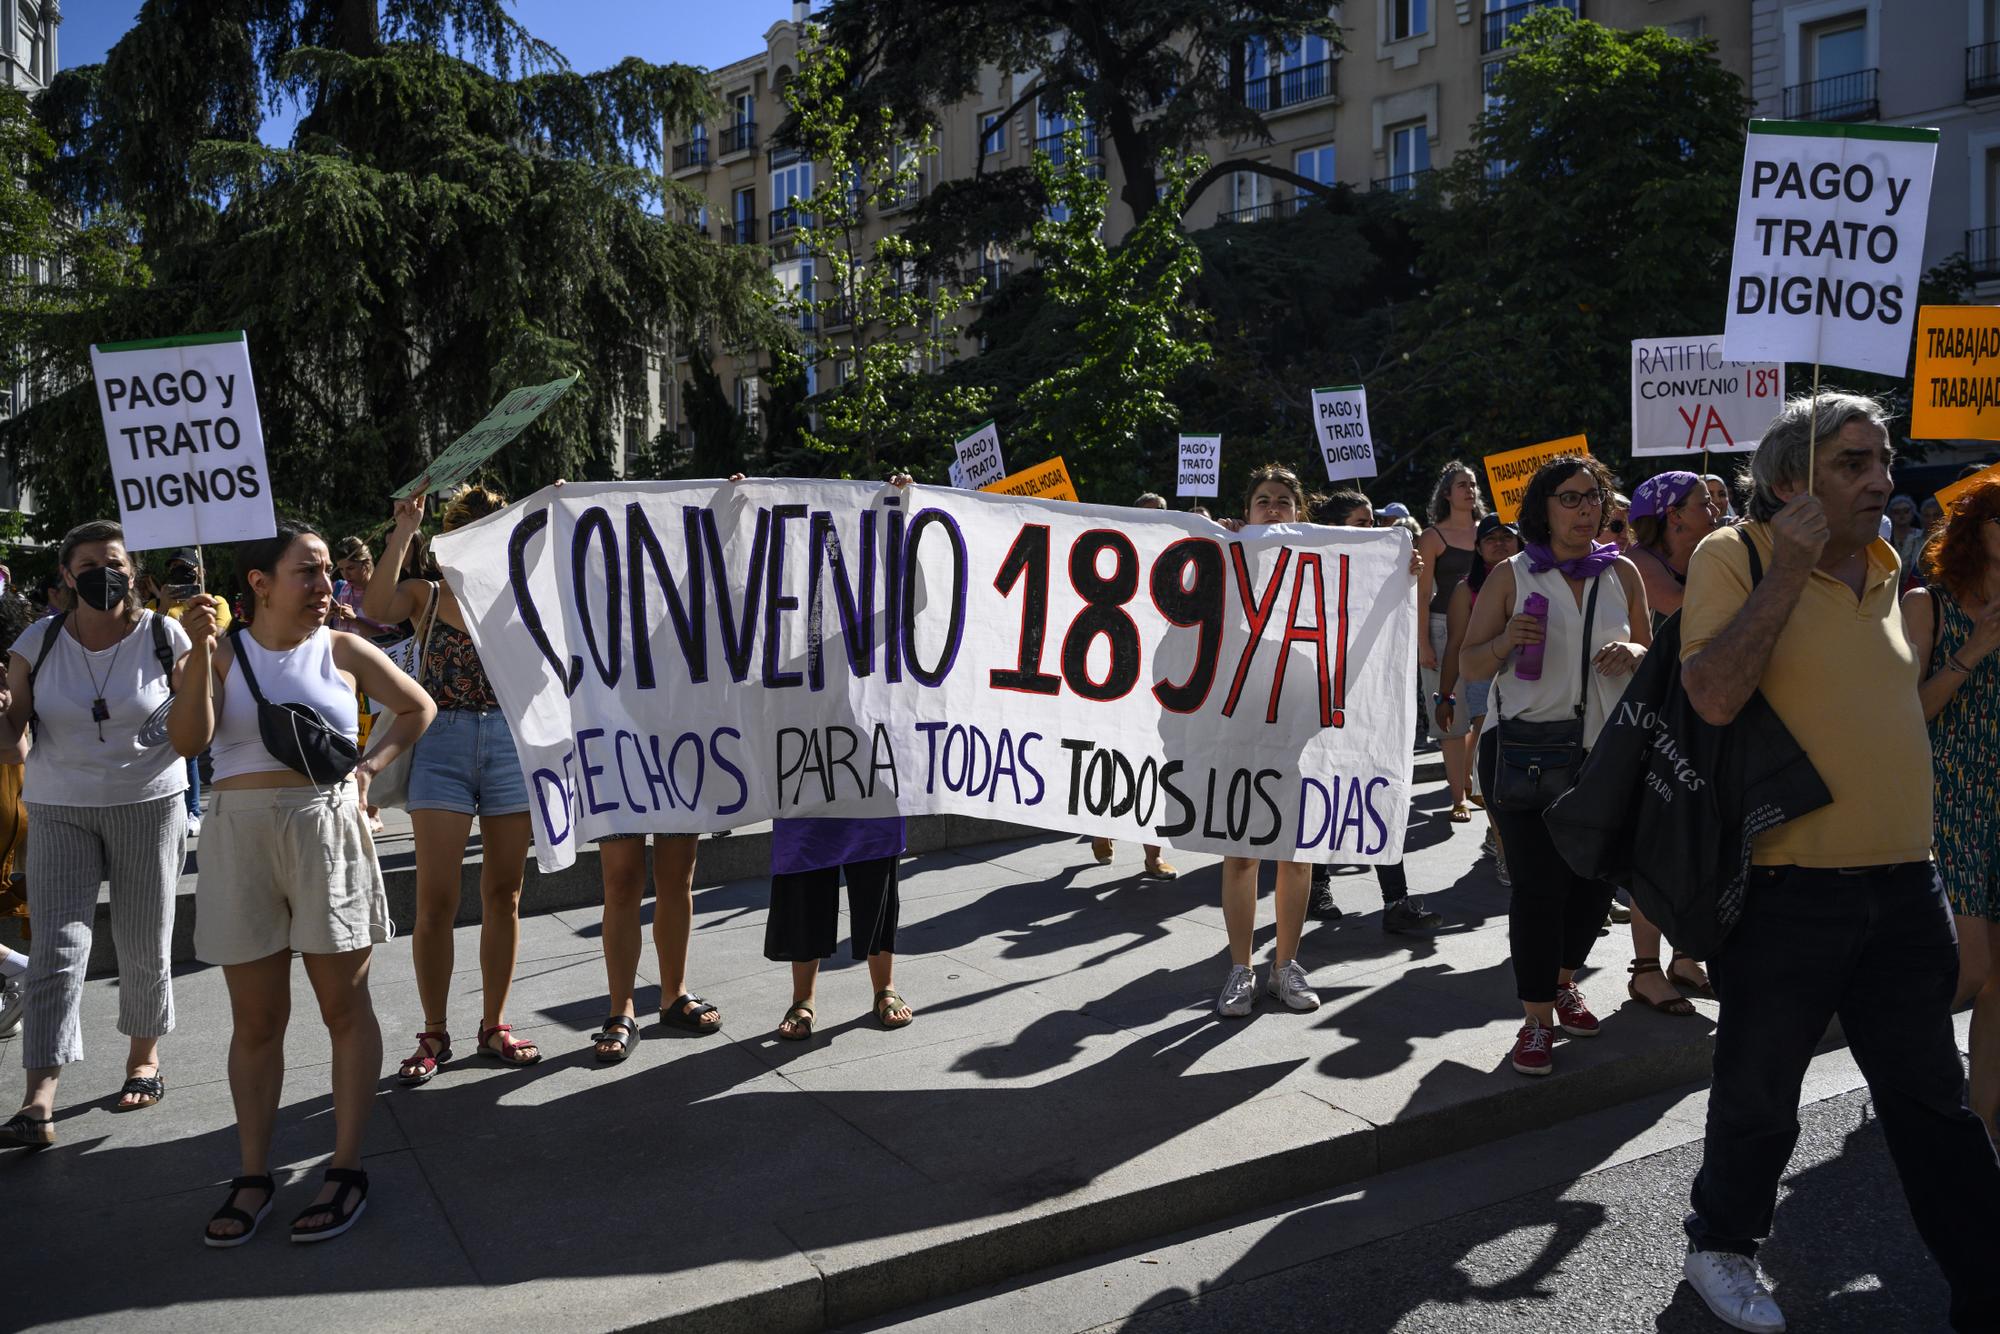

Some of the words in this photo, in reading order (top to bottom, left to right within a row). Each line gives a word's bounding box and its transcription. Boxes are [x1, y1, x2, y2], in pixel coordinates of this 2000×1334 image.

[1751, 161, 1873, 202] PAGO
[1885, 177, 1911, 216] y
[1756, 218, 1898, 264] TRATO
[1736, 276, 1903, 325] DIGNOS
[104, 369, 206, 411] PAGO
[216, 374, 235, 408] y
[1641, 377, 1738, 400] CONVENIO
[1747, 368, 1778, 398] 189
[1320, 401, 1351, 419] PAGO
[1355, 403, 1361, 419] y
[120, 416, 240, 460] TRATO
[1326, 422, 1364, 441] TRATO
[1678, 404, 1734, 449] YA
[960, 438, 986, 464] PAGO
[988, 436, 994, 451] y
[1181, 443, 1207, 454] PAGO
[1209, 446, 1215, 457] y
[1182, 459, 1213, 470] TRATO
[1327, 443, 1371, 464] DIGNOS
[966, 454, 997, 482] TRATO
[1179, 474, 1215, 485] DIGNOS
[121, 465, 260, 511] DIGNOS
[1025, 478, 1041, 496] DEL
[989, 523, 1226, 714] 189
[1221, 541, 1350, 729] YA!
[777, 722, 899, 810] PARA
[915, 721, 1046, 806] TODAS
[1060, 738, 1197, 838] TODOS
[1202, 768, 1283, 846] LOS
[1296, 775, 1390, 856] DIAS
